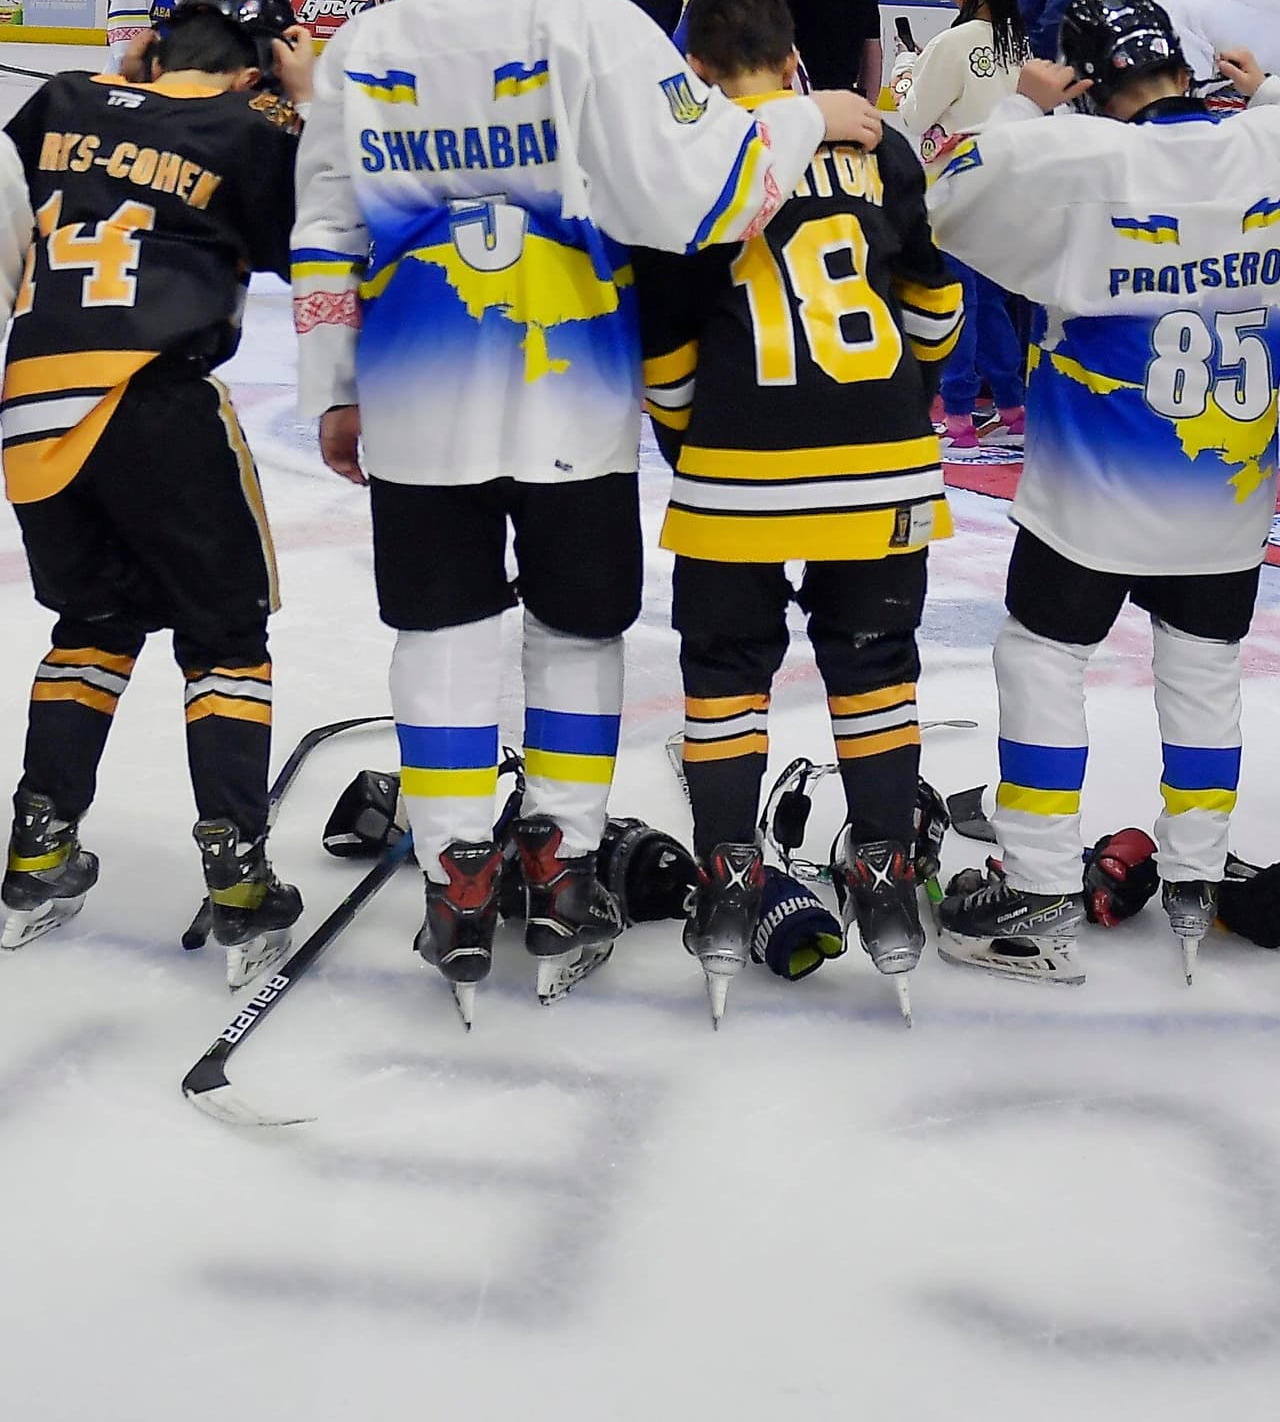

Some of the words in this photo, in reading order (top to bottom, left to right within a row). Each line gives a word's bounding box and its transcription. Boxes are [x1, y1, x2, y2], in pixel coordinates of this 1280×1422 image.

[729, 212, 904, 387] 18
[1144, 306, 1273, 422] 85
[997, 906, 1029, 924] BAUER
[219, 974, 290, 1044] BAUER
